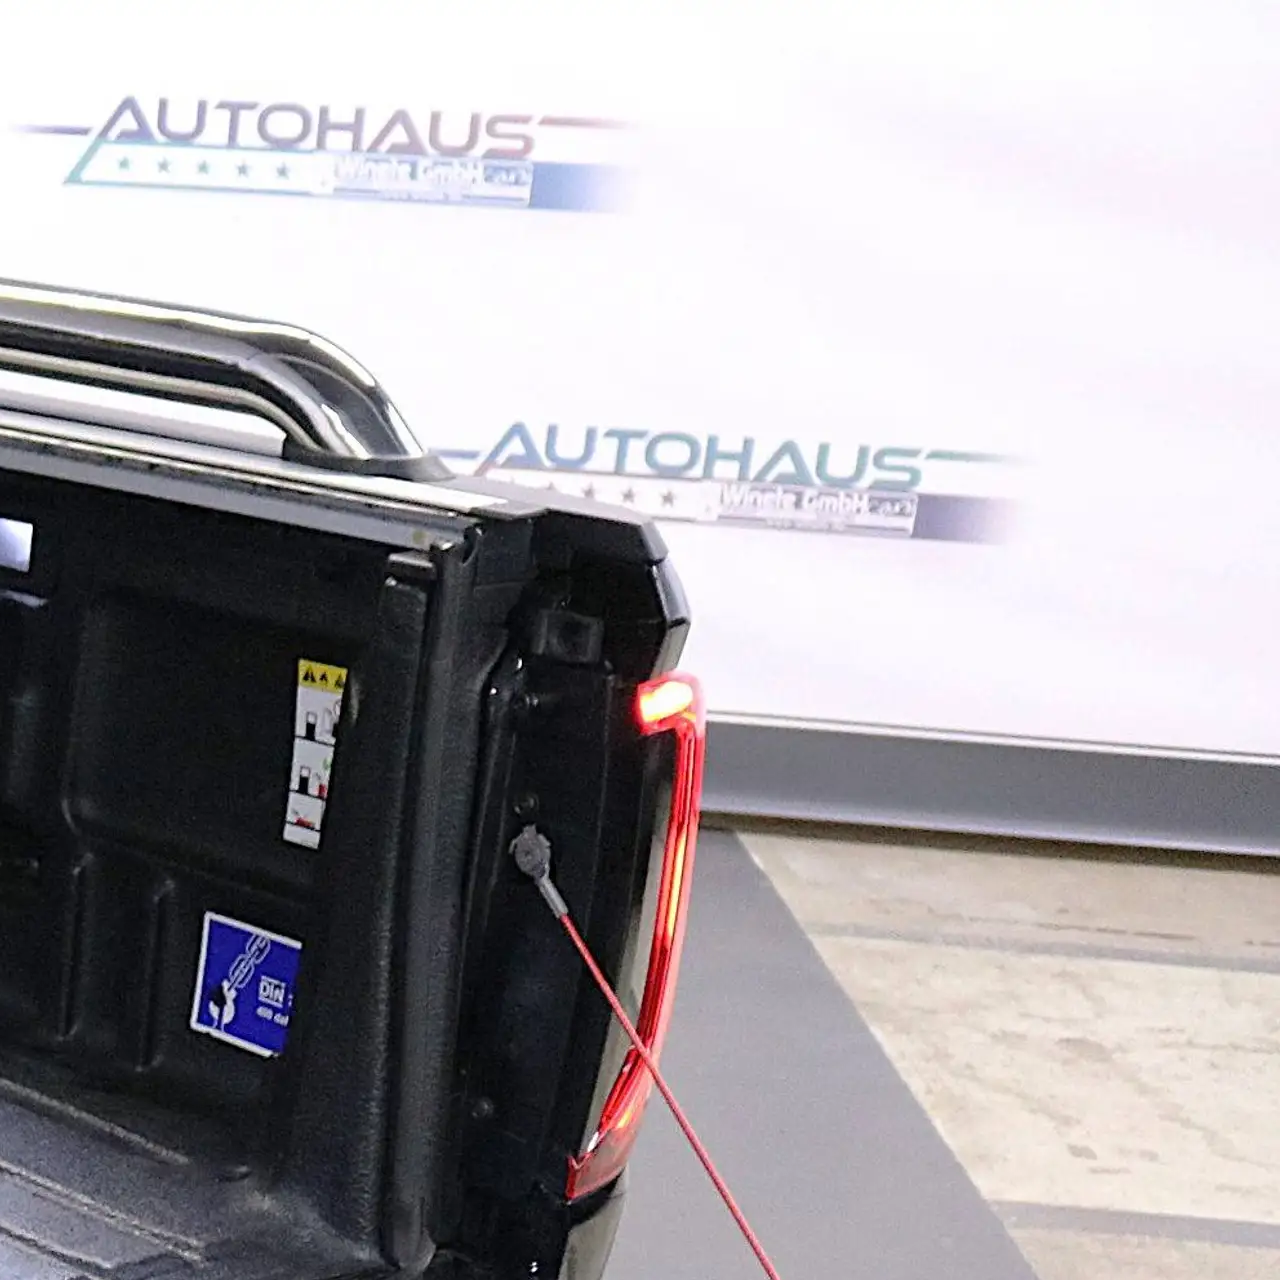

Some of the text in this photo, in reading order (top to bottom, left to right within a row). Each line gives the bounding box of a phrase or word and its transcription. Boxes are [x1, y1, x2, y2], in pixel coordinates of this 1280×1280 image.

[88, 95, 537, 160] AUTOHAUS
[474, 421, 923, 490] AUTOHAUS
[258, 977, 286, 1007] DIN
